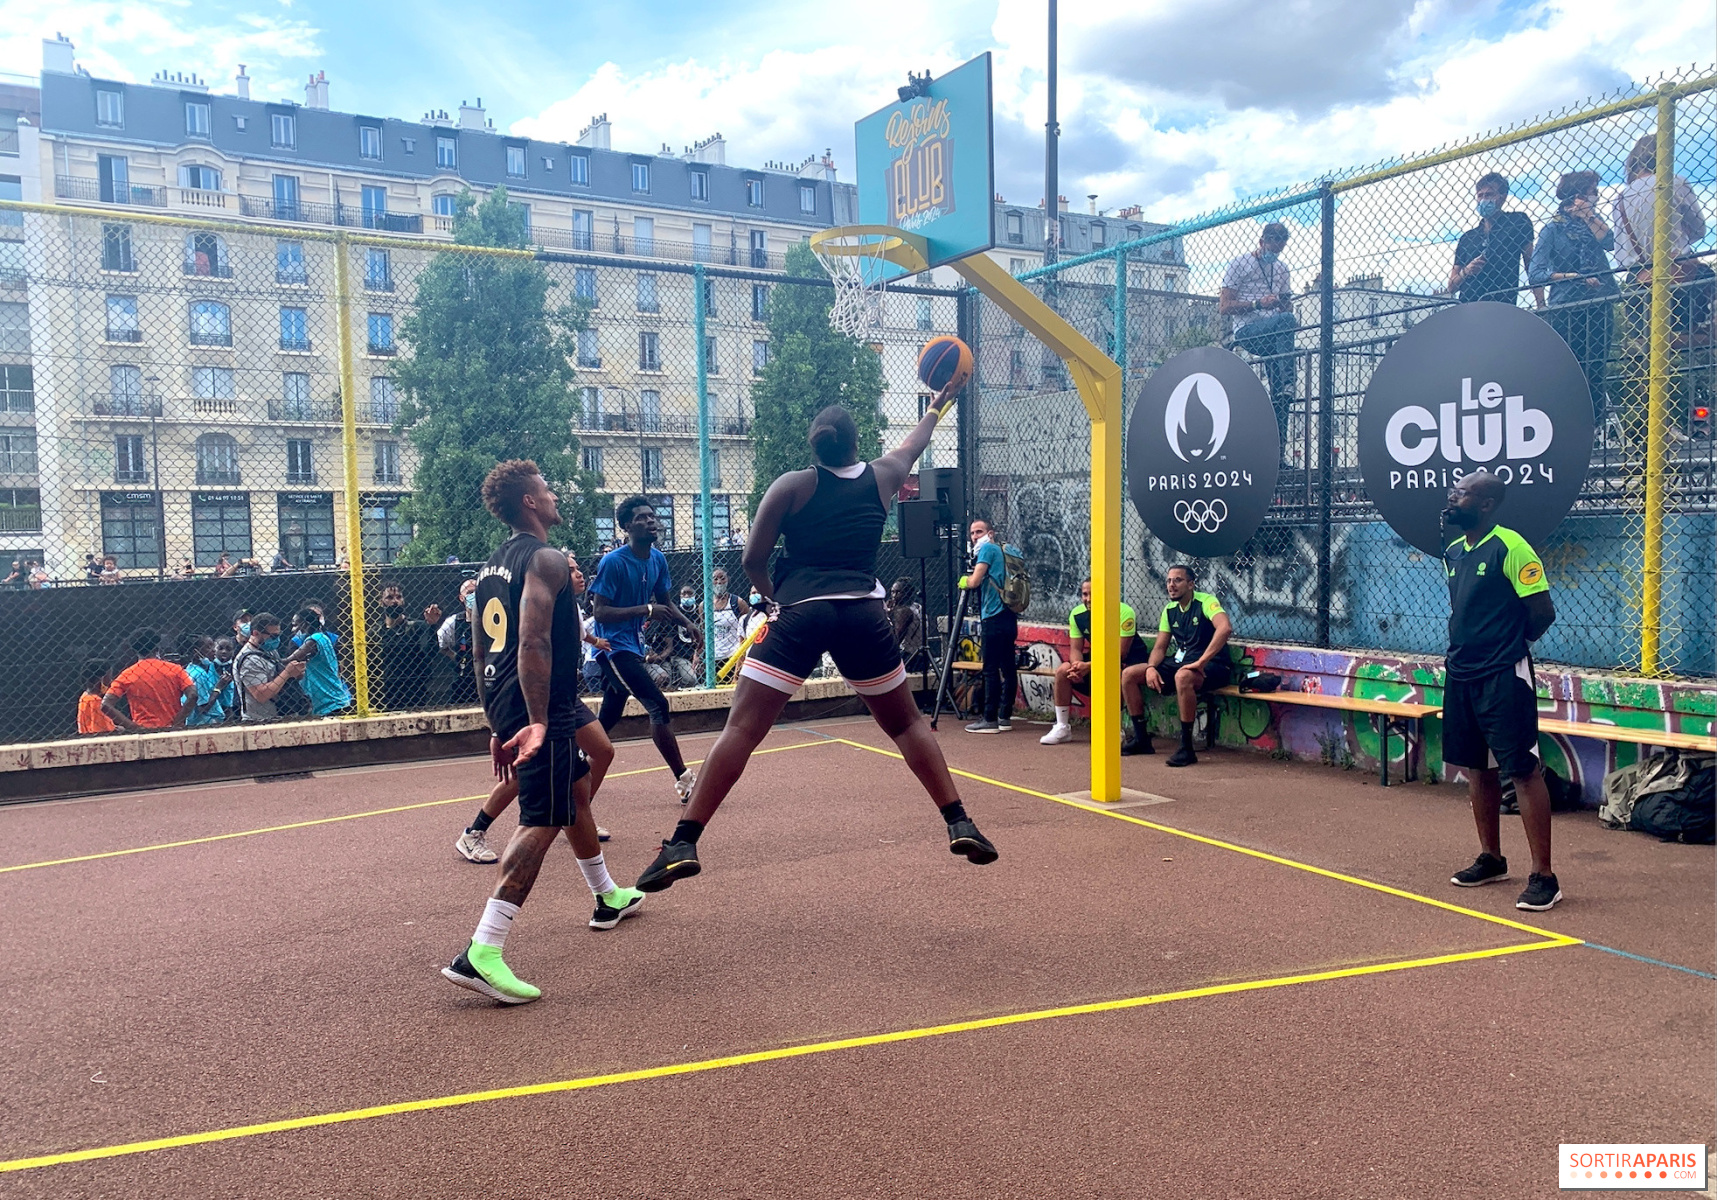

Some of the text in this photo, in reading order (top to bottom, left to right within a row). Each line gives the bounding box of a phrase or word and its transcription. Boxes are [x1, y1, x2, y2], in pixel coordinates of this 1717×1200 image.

[885, 97, 951, 165] Rejoins
[894, 141, 945, 219] CLUB
[923, 205, 941, 226] 2024
[1461, 377, 1504, 411] Le
[1385, 395, 1554, 466] Club
[1149, 470, 1252, 491] PARIS 2024
[1390, 468, 1464, 490] PARIS
[482, 597, 507, 653] 9
